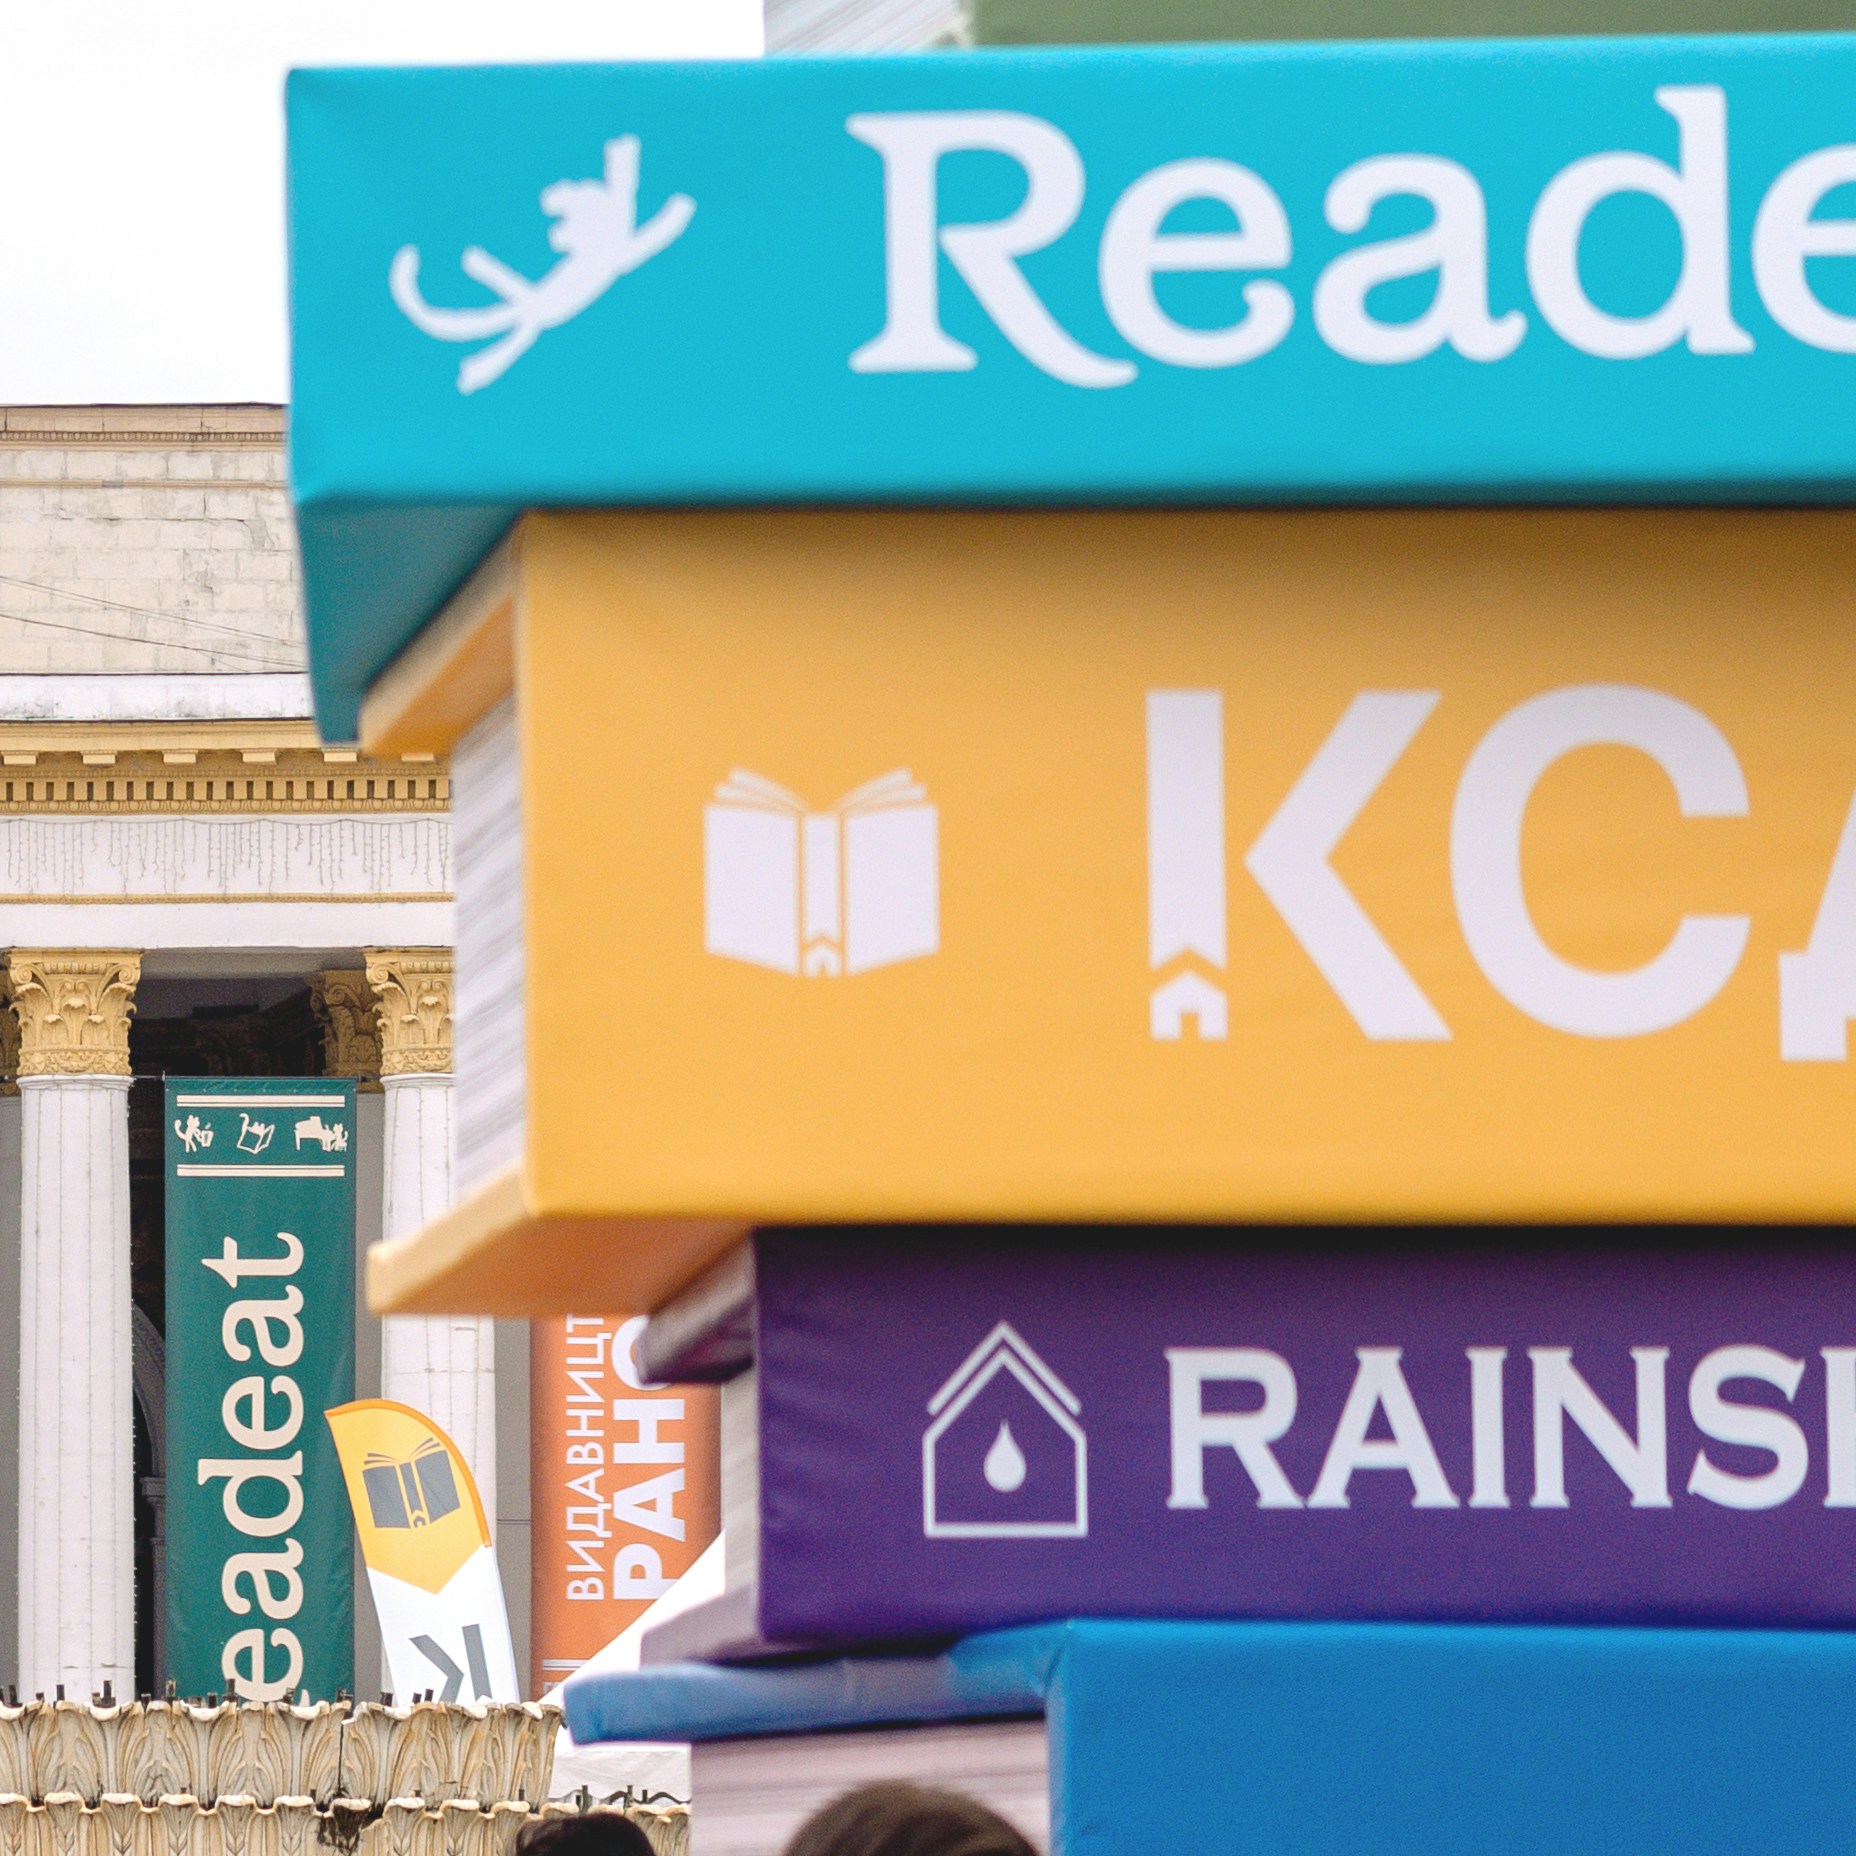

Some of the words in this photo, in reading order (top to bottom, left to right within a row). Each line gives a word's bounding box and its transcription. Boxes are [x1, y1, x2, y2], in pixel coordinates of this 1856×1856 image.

[1146, 683, 1856, 1062] КС
[197, 1231, 308, 1704] eadeat
[1164, 1345, 1856, 1513] RAINS
